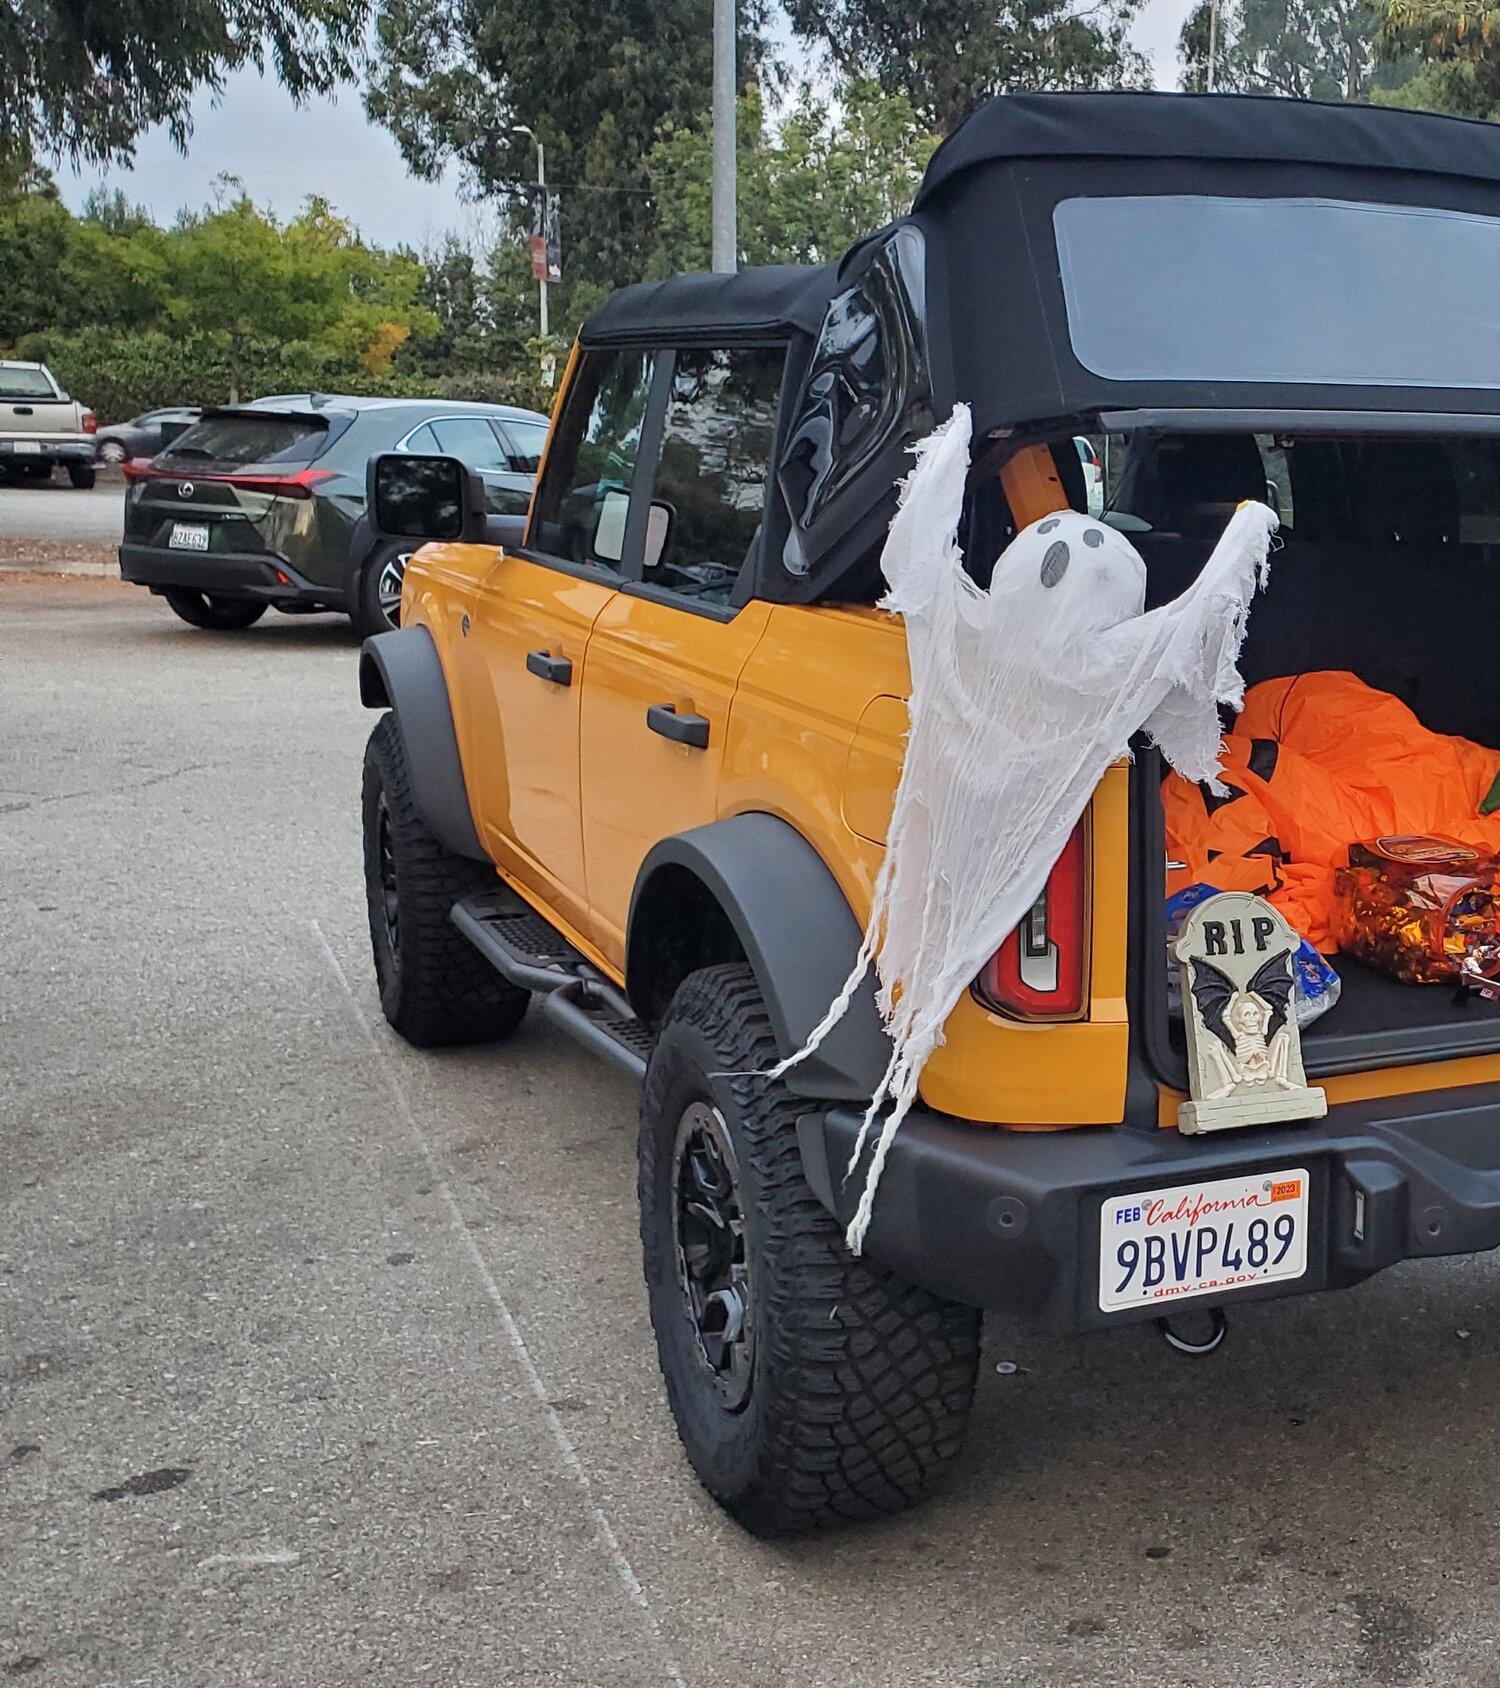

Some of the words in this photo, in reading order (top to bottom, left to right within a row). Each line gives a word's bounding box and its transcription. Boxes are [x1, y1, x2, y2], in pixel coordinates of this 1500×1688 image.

[1202, 917, 1275, 956] RIP
[1116, 1207, 1141, 1225] FEB
[1147, 1193, 1272, 1226] California
[1276, 1184, 1296, 1195] 2023
[1115, 1214, 1295, 1293] 9BVP489
[1154, 1273, 1258, 1297] dmv.ca.gov
